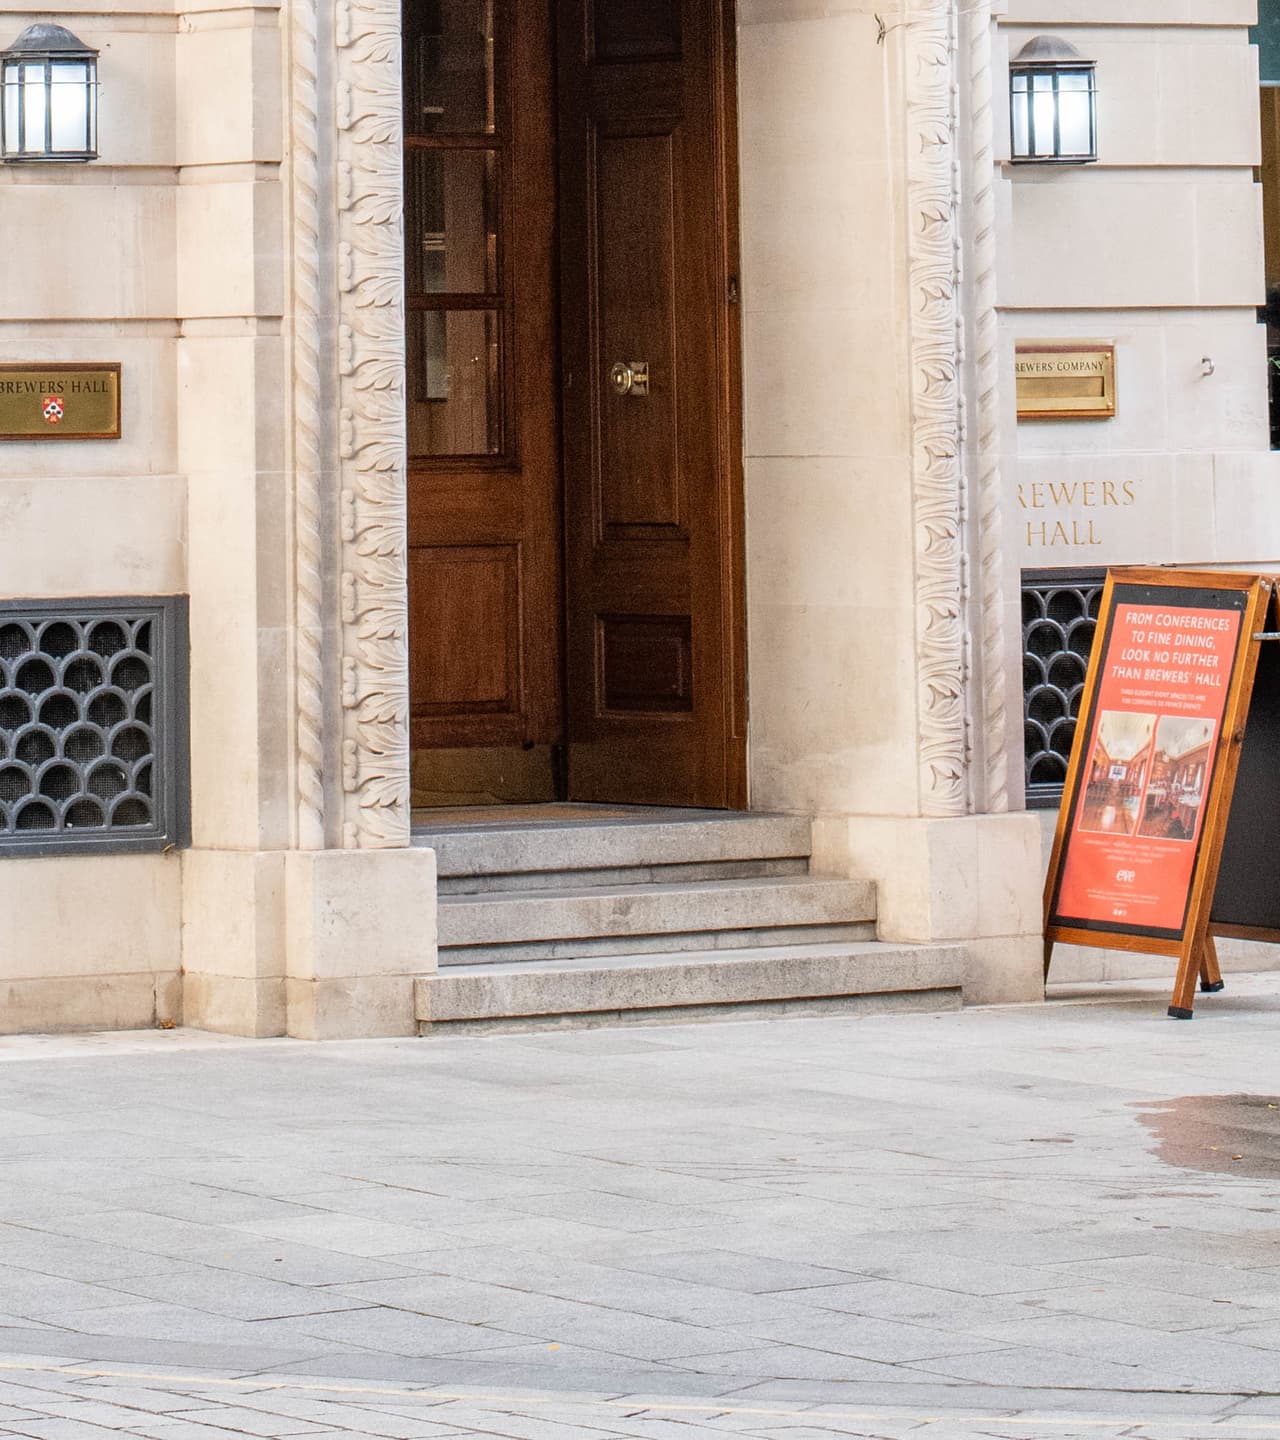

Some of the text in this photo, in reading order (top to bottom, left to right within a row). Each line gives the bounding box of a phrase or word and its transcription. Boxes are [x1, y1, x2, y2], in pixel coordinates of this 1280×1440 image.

[1015, 360, 1104, 372] REWERS' COMPANY
[71, 380, 109, 393] HALL
[1026, 519, 1102, 547] HALL
[1125, 611, 1230, 631] FROM CONFERENCES
[1131, 630, 1216, 649] TO FINE DINING,
[1121, 648, 1219, 668] LOOK NO FURTHER
[1112, 665, 1221, 687] THAN BREWERS' HALL
